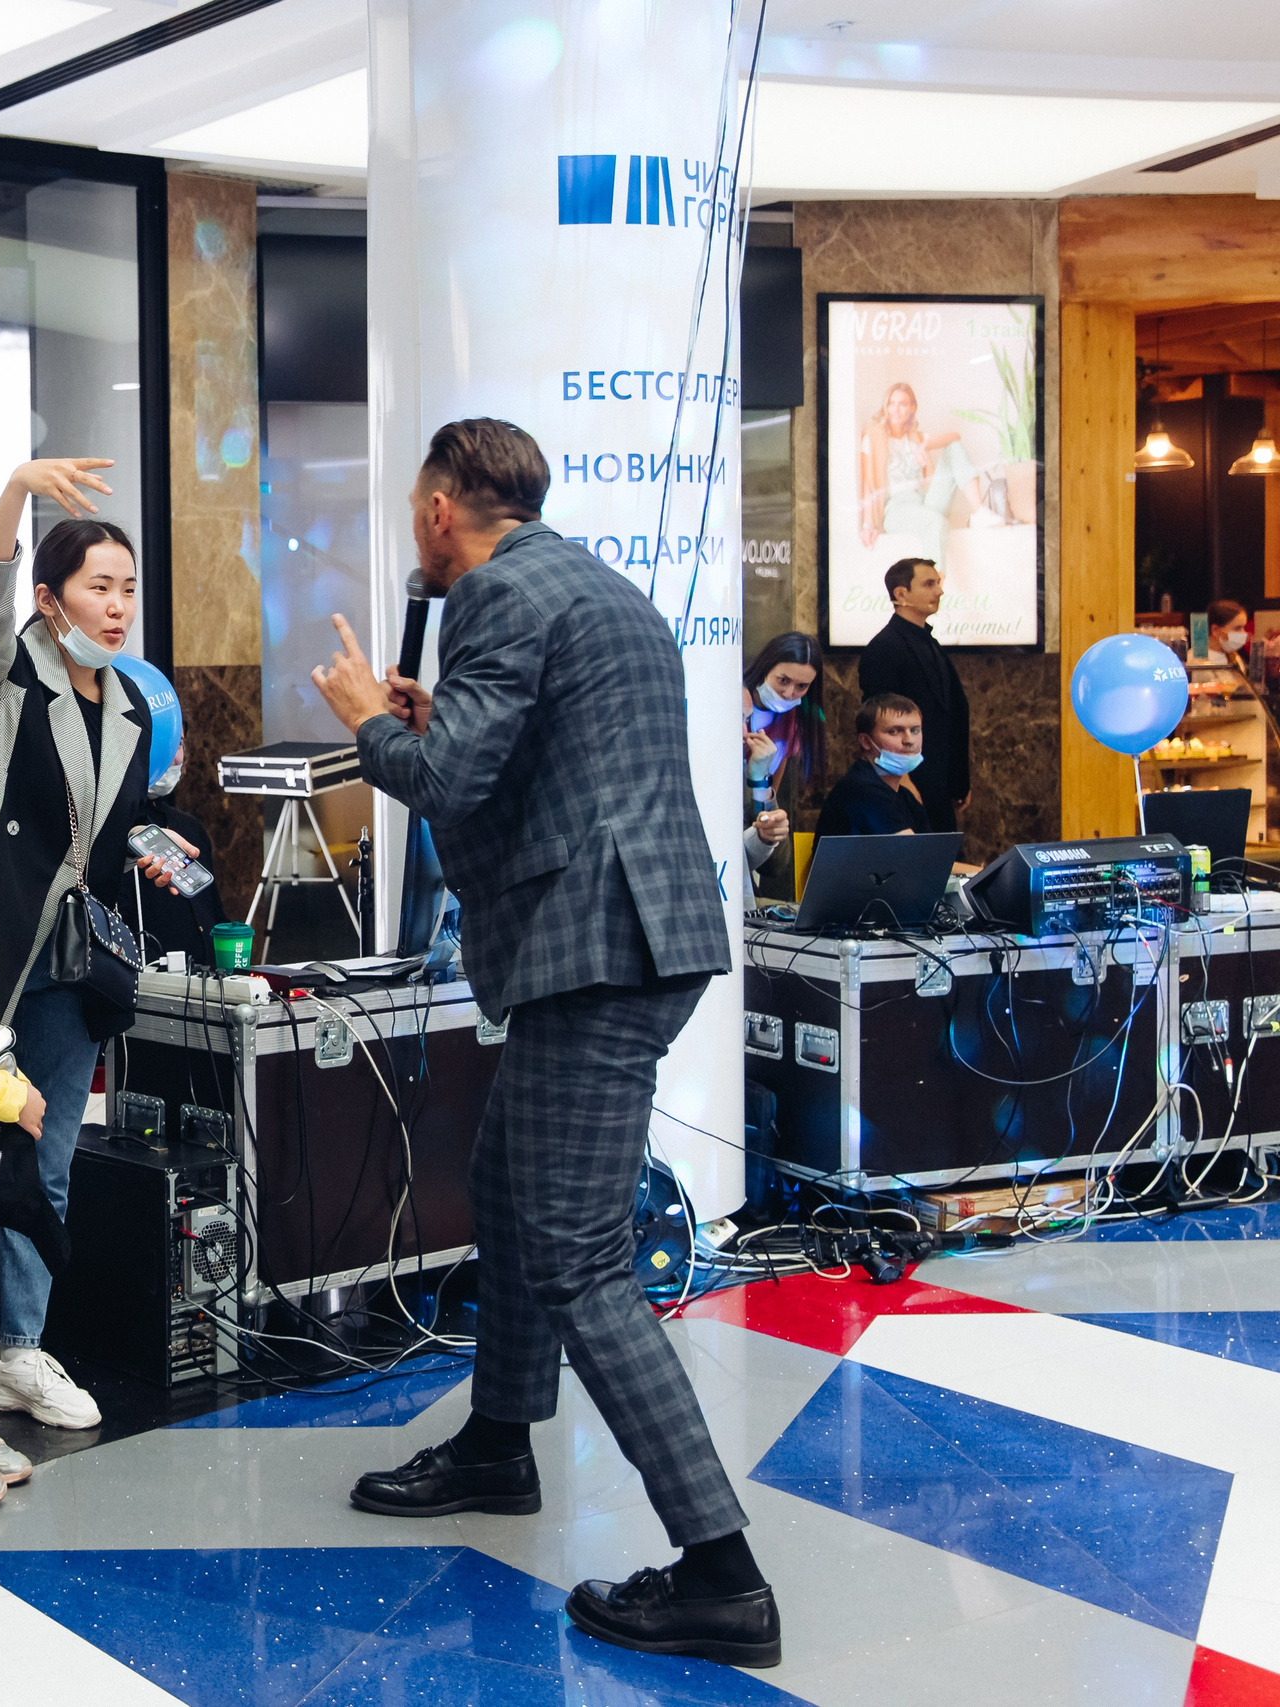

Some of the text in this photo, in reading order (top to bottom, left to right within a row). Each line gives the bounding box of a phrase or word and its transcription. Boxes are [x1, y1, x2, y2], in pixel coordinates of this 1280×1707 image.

[871, 311, 942, 342] GRAD
[563, 371, 740, 409] БЕСТСЕЛЛЕР
[564, 453, 725, 485] НОВИНКИ
[1046, 848, 1091, 862] YAMAHA
